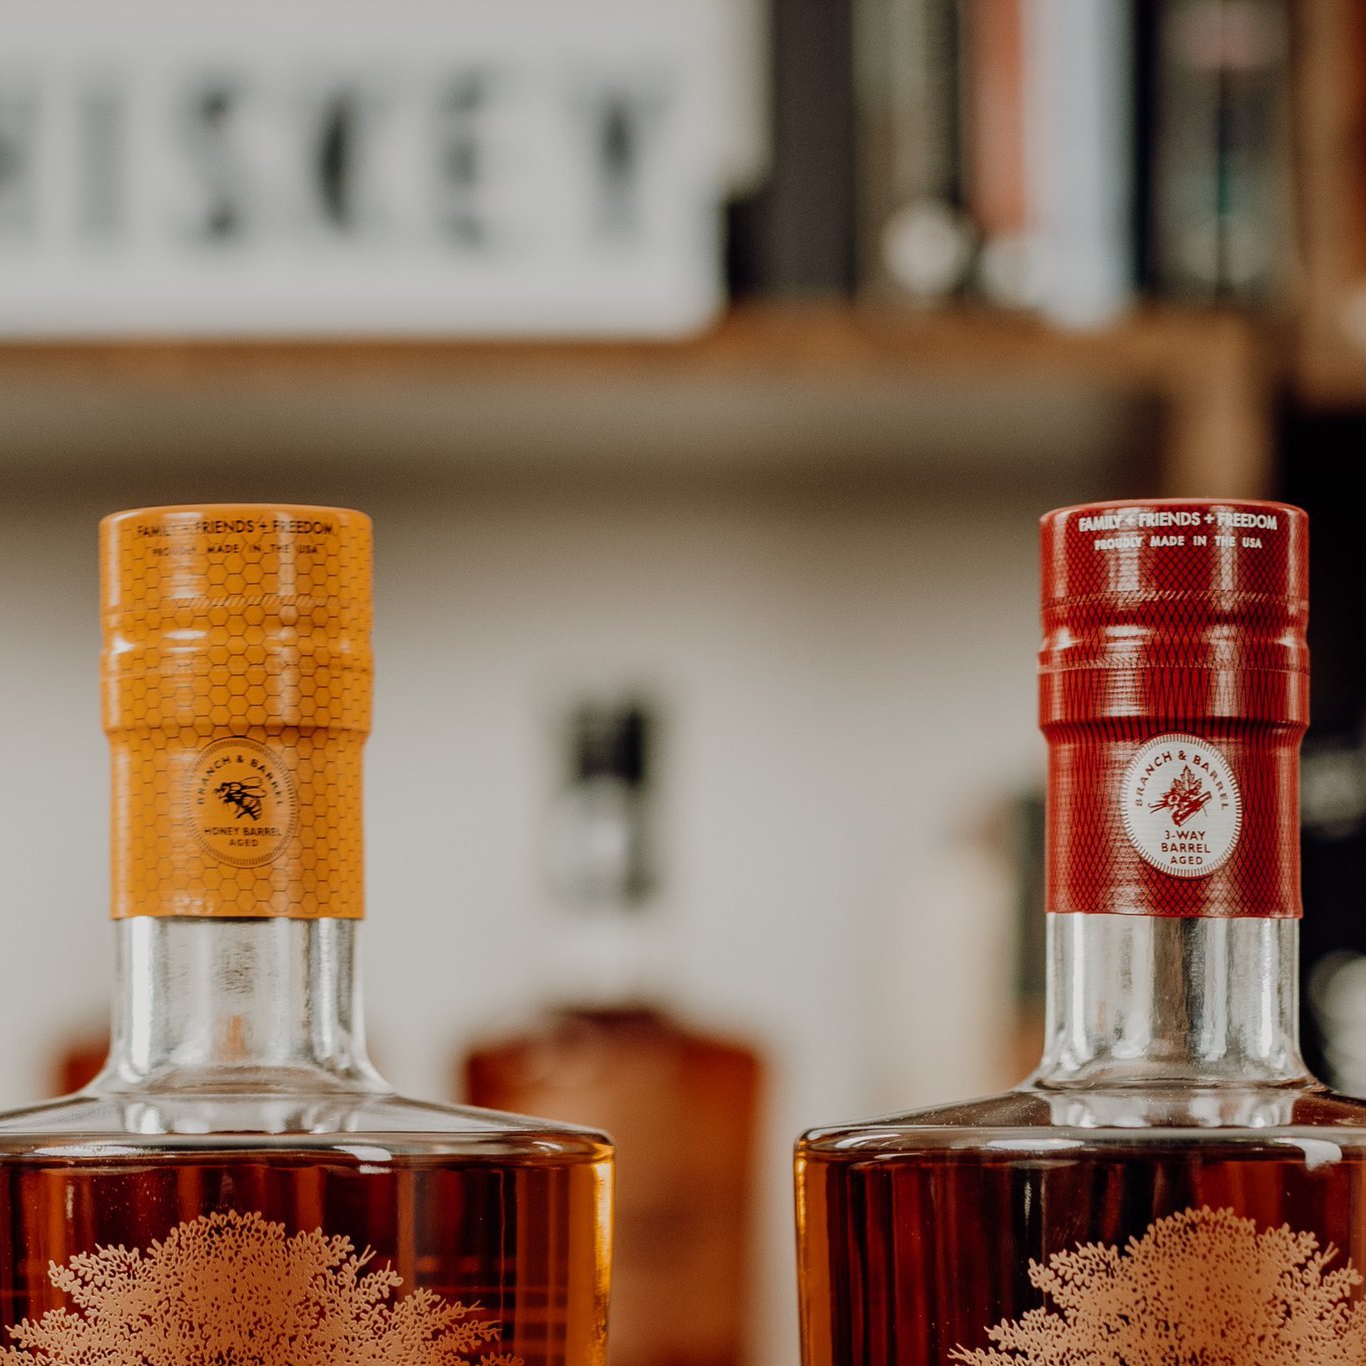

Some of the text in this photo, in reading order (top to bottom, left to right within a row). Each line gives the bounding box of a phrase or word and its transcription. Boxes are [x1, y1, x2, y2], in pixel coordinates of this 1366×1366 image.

[1079, 515, 1121, 532] FAMILY
[1139, 512, 1200, 527] FRIENDS
[1217, 512, 1277, 530] FREEDOM
[137, 524, 181, 536] FAMIL
[196, 520, 255, 533] FRIENDS
[273, 520, 332, 534] FREEDOM
[1094, 536, 1262, 550] PROUDLY MADE IN THE USA
[207, 544, 239, 553] MADE
[1135, 750, 1229, 810] BRANCH & BARREL
[205, 827, 281, 836] HONEY BARREL
[1165, 831, 1206, 840] 3-WAY
[229, 839, 258, 847] AGED
[1161, 843, 1210, 853] BARREL
[1170, 856, 1203, 865] AGED
